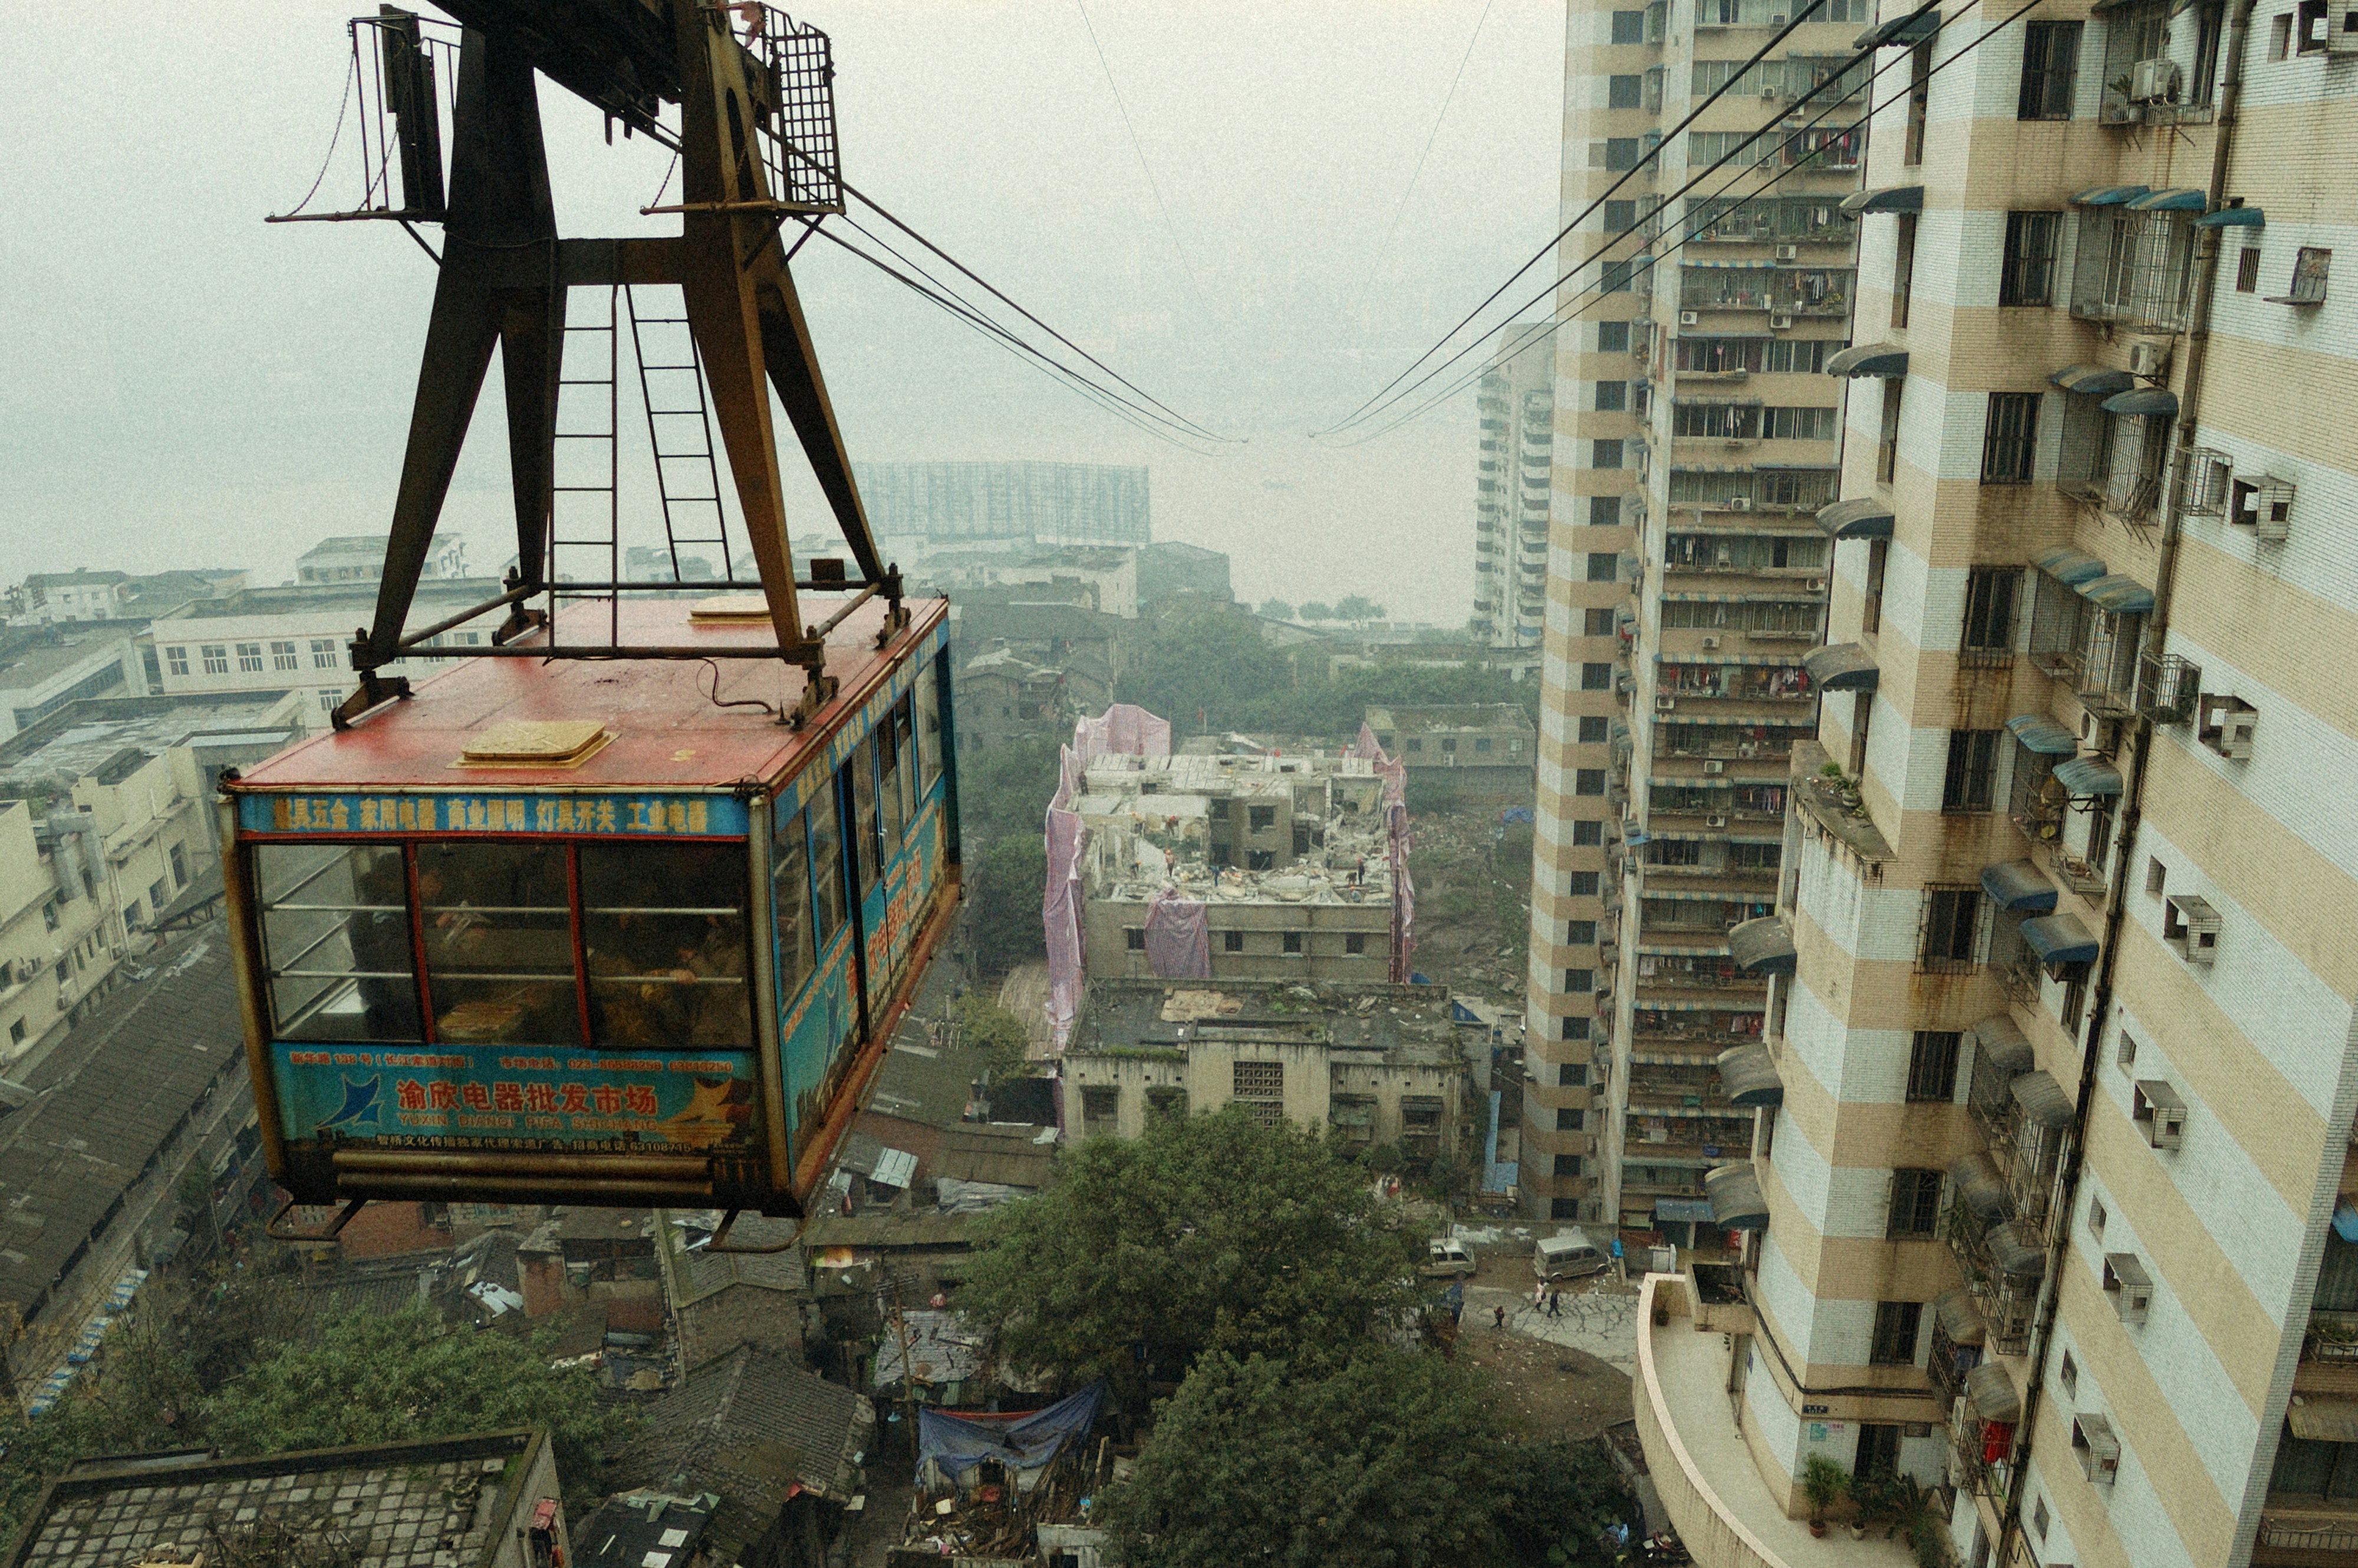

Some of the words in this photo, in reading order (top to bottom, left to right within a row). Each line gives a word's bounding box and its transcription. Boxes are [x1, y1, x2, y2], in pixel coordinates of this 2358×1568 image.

[360, 798, 436, 832] 家用电器
[447, 799, 525, 832] 商业照明
[536, 799, 615, 833] 灯具开关
[627, 800, 706, 833] 工业电器
[396, 1079, 658, 1115] 渝欣电器批发市场
[397, 1113, 448, 1127] YUXIN
[458, 1114, 515, 1129] DIANQI
[526, 1116, 563, 1129] PIFA
[572, 1118, 658, 1131] SHICHANG
[572, 1139, 626, 1152] 招商电话
